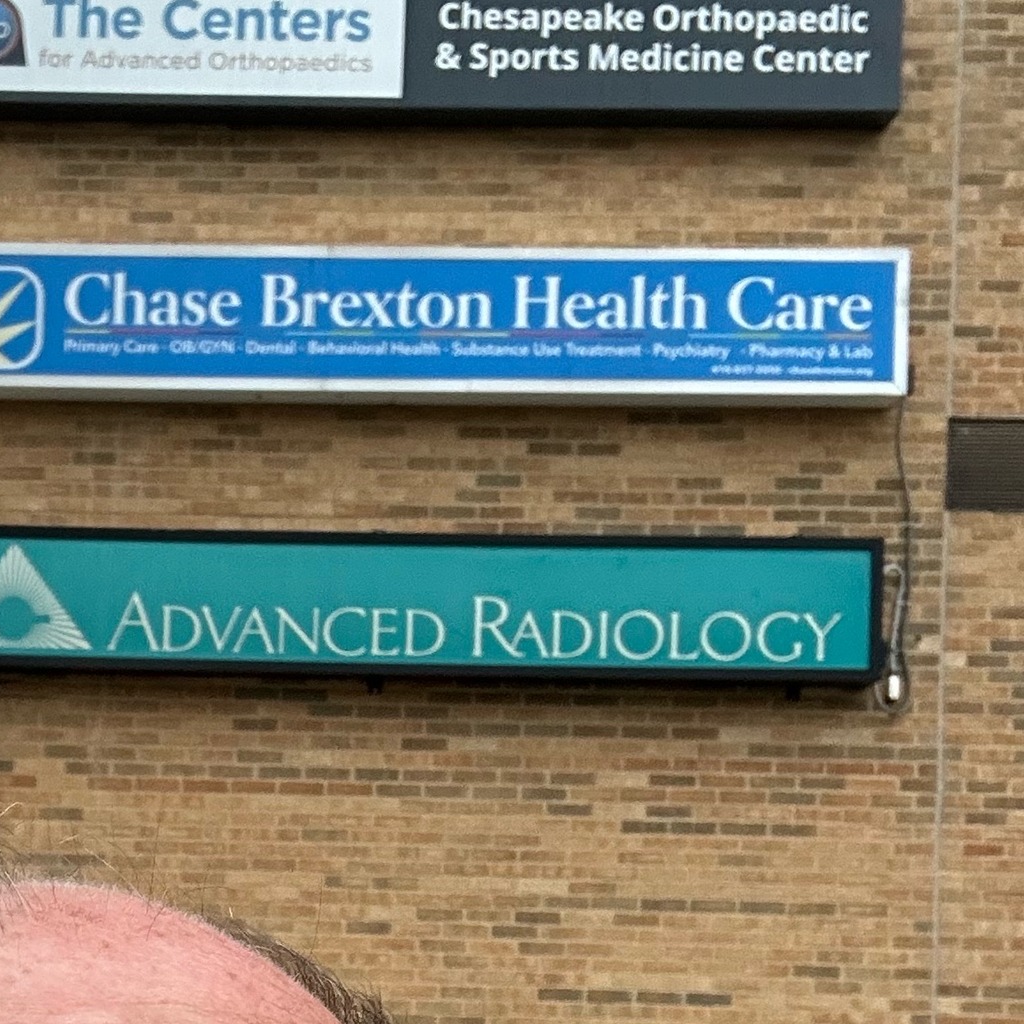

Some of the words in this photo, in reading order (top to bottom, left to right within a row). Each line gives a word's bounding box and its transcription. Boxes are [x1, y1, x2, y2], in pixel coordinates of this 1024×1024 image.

[42, 0, 144, 40] The
[162, 0, 371, 43] Centers
[438, 0, 645, 39] Chesapeake
[652, 2, 869, 41] Orthopaedic
[37, 46, 74, 69] for
[79, 49, 202, 72] Advanced
[207, 51, 373, 75] Orthopaedics
[434, 42, 462, 70] &
[468, 42, 579, 78] Sports
[588, 42, 745, 73] Medicine
[752, 44, 871, 74] Center
[64, 272, 242, 327] Chase
[261, 274, 492, 329] Brexton
[513, 274, 707, 330] Health
[727, 276, 873, 332] Care
[63, 338, 122, 356] Primary
[122, 338, 160, 354] Care
[244, 339, 297, 355] Dental
[306, 339, 389, 356] Behavioral
[389, 339, 442, 356] Health
[451, 339, 531, 357] Substance
[532, 340, 562, 357] Use
[563, 338, 644, 358] Treatment
[651, 341, 732, 362] Psychiatry
[747, 342, 827, 362] Pharmacy
[826, 342, 843, 360] &
[842, 342, 874, 360] Lab
[107, 591, 446, 657] ADVANCED
[472, 595, 841, 662] RADIOLOGY
